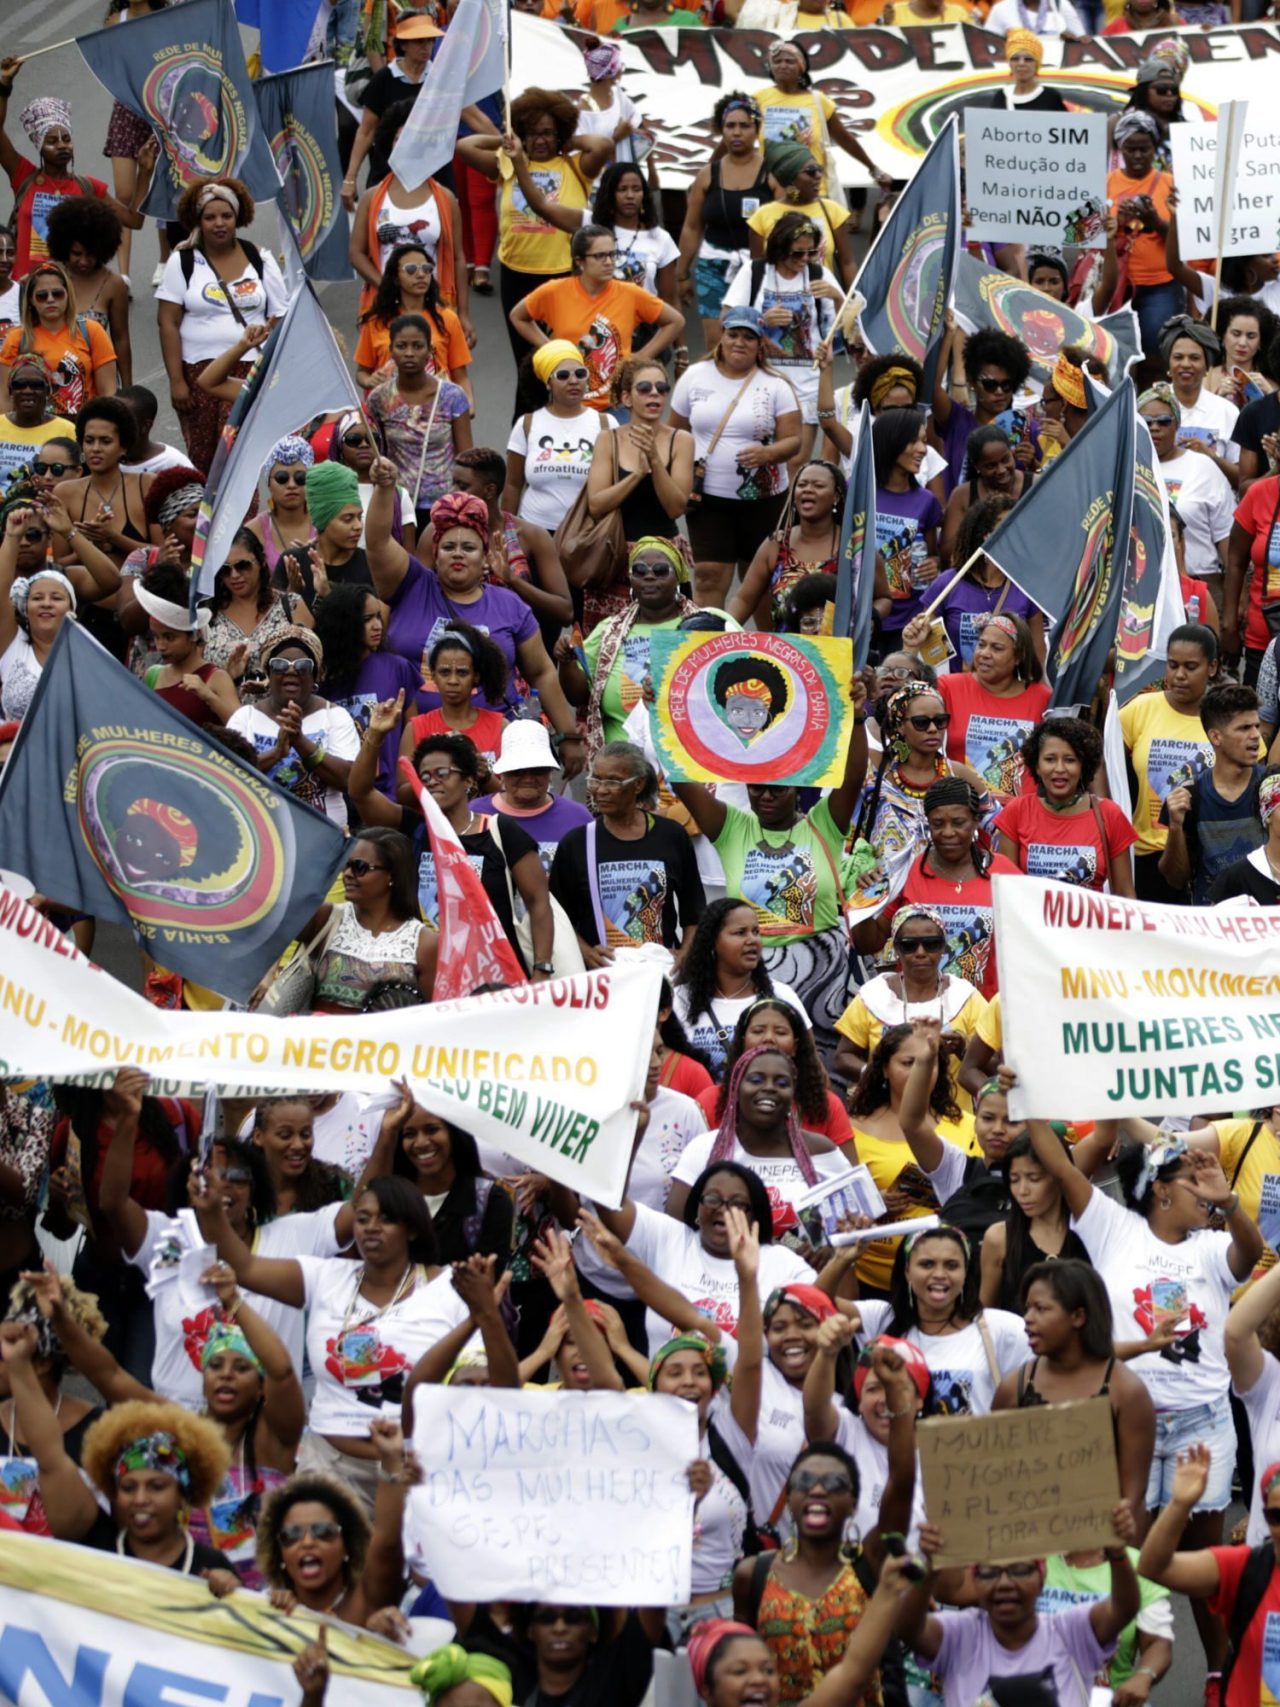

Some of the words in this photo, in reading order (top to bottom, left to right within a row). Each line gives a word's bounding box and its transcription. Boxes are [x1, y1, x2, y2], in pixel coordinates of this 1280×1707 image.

[981, 127, 1042, 144] Aborto
[1048, 127, 1089, 145] SIM
[1190, 136, 1219, 151] Ne
[984, 155, 1060, 175] Redução
[1065, 158, 1086, 173] da
[982, 182, 1090, 201] Maioridade
[1194, 192, 1274, 214] Mher
[969, 207, 1013, 225] Penal
[1016, 206, 1062, 227] NÃO
[1196, 225, 1260, 245] Ngra
[533, 464, 590, 475] afroatitud
[874, 514, 905, 526] ARCHA
[675, 669, 693, 686] DE
[687, 633, 759, 668] MULHERES
[764, 636, 807, 671] NEGRAS
[970, 715, 1019, 728] MARCHA
[1151, 738, 1198, 751] MARCHA
[91, 726, 203, 753] MULHERES
[208, 750, 281, 810] NEGRAS
[1028, 845, 1079, 856] MARCHA
[601, 862, 650, 873] MARCHA
[934, 905, 976, 916] ARCHA
[164, 928, 232, 944] BAHIA
[1062, 1016, 1244, 1055] MULHERES
[282, 1036, 400, 1076] NEGRO
[412, 1043, 598, 1087] UNIFICADO
[1107, 1059, 1244, 1101] JUNTAS
[478, 1080, 528, 1129] BEM
[530, 1100, 600, 1165] VIVER
[446, 1405, 651, 1469] MARCHAS
[429, 1468, 494, 1507] DAS
[966, 1496, 999, 1520] PL
